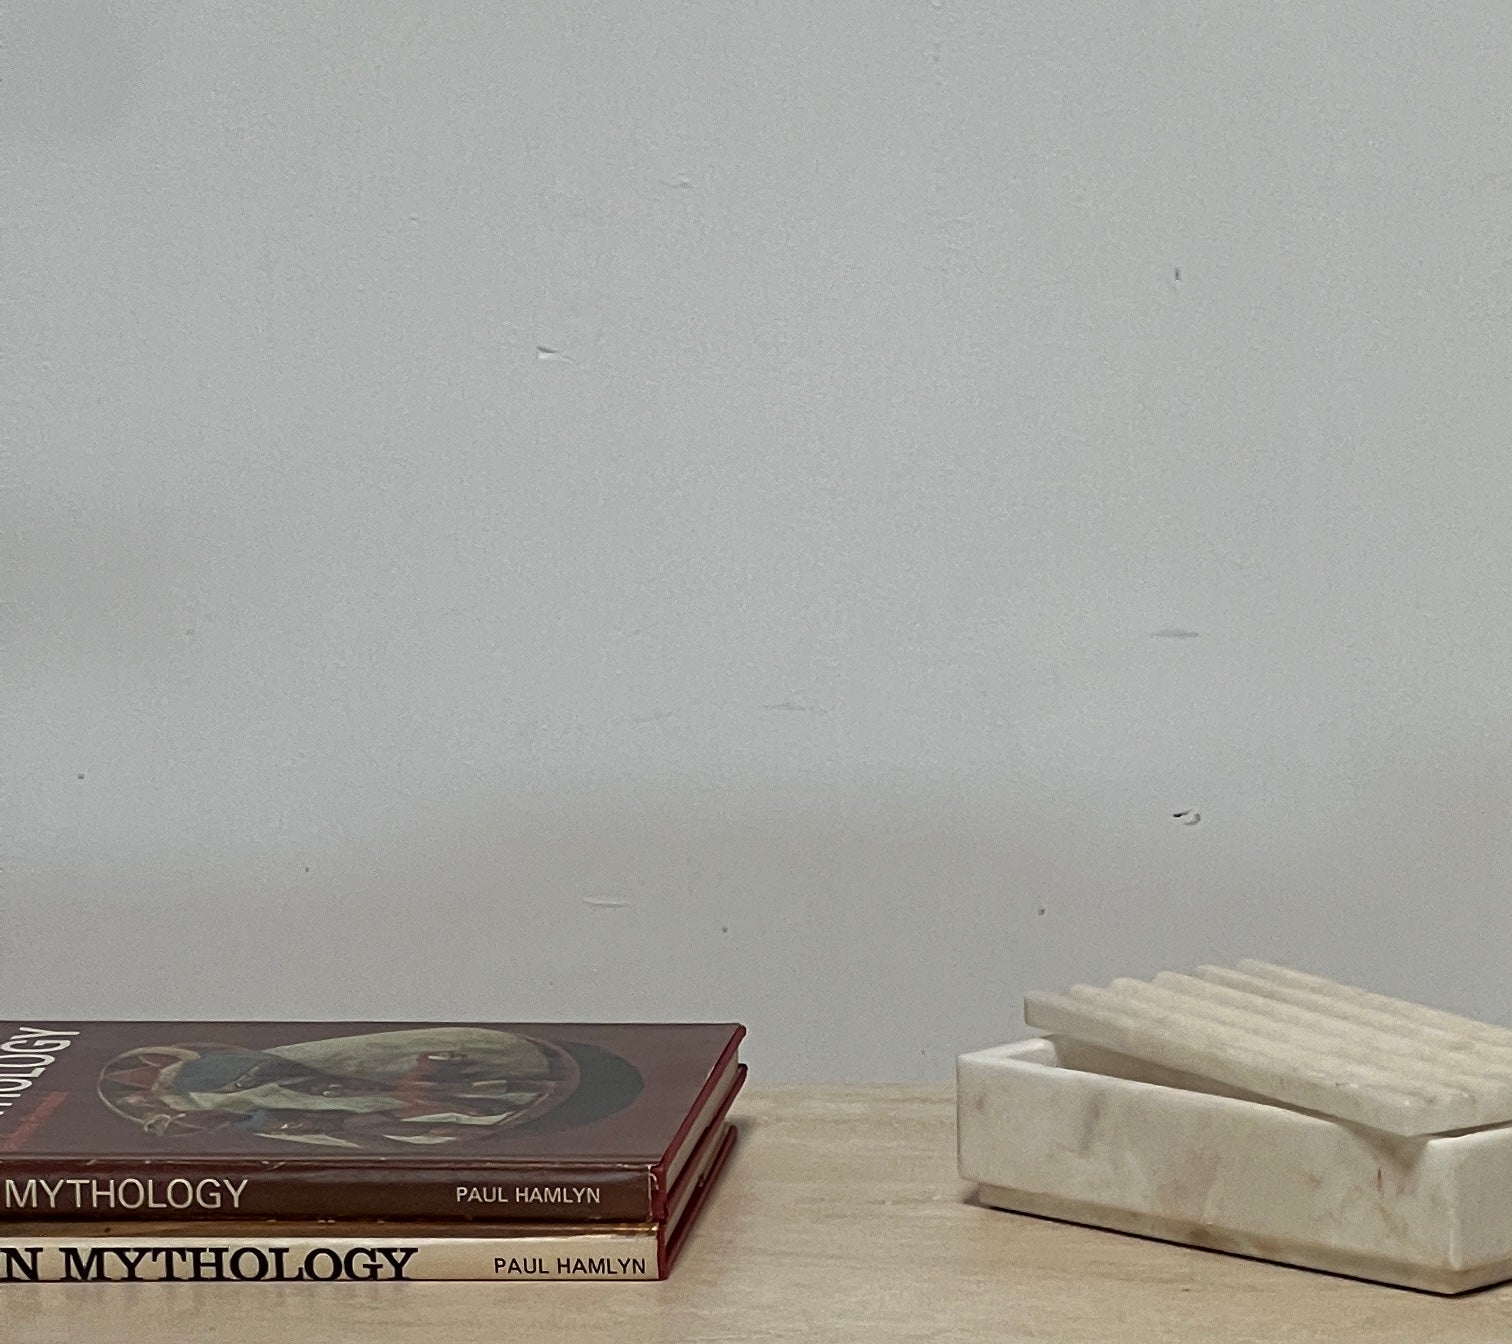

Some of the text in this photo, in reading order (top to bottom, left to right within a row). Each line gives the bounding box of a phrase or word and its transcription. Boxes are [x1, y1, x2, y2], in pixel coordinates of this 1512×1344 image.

[5, 1178, 248, 1209] MYTHOLOGY
[456, 1186, 601, 1204] PAUL HAMLYN
[59, 1246, 418, 1281] MYTHOLOGY
[494, 1257, 646, 1275] PAUL HAMLYN
